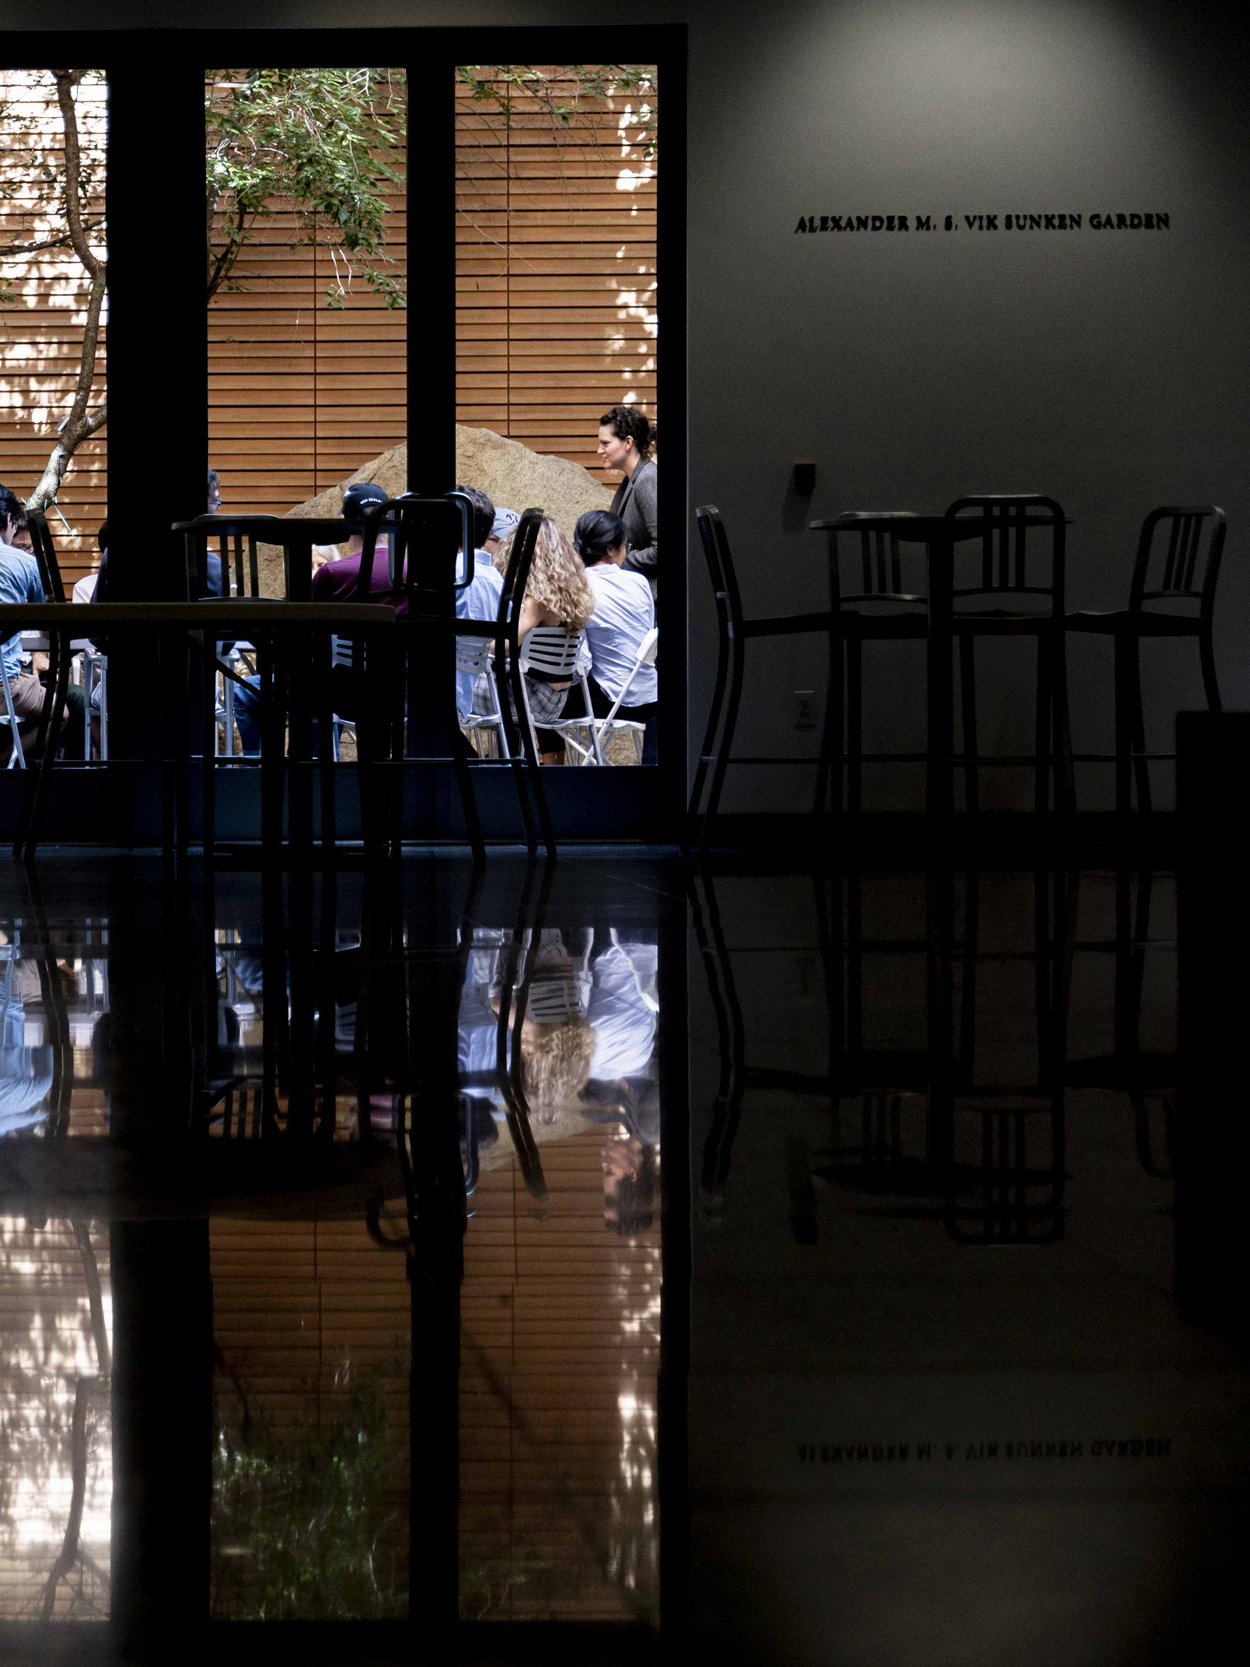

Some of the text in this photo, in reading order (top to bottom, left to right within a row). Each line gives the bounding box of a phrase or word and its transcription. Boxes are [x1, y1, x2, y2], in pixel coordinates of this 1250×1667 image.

[794, 215, 910, 233] ALEXANDER
[916, 215, 937, 231] M.
[965, 214, 999, 231] VIK
[1005, 213, 1082, 230] SUNKEN
[1089, 212, 1170, 230] GARDEN
